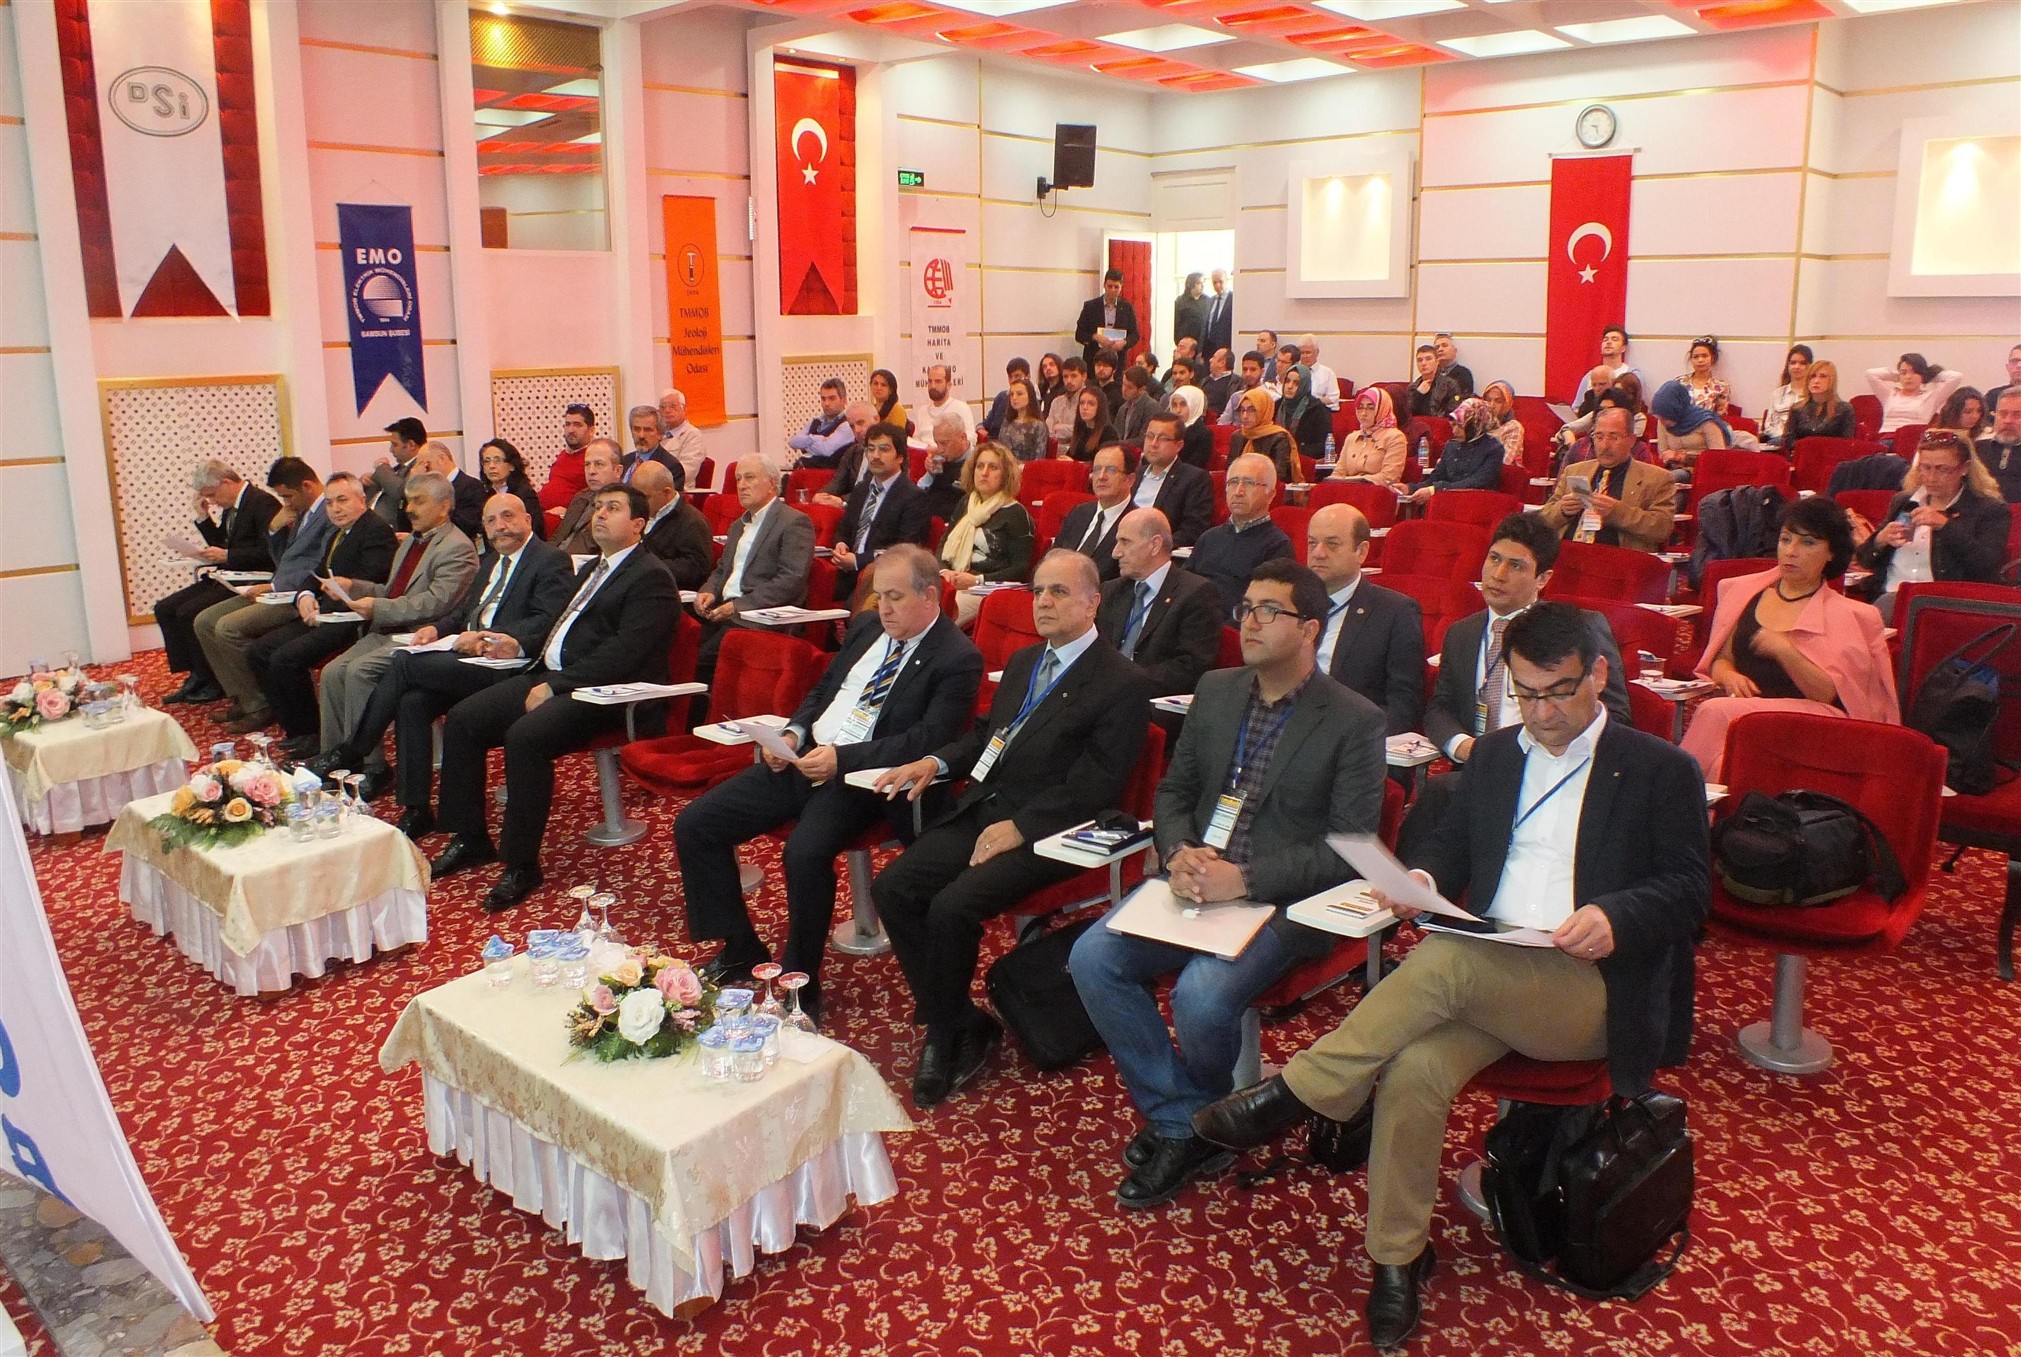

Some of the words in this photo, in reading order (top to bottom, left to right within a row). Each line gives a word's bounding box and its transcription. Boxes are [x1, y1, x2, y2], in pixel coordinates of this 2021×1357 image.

[355, 247, 403, 265] EMO
[679, 307, 710, 318] TMMOB
[684, 327, 708, 338] Jeoloji
[928, 325, 950, 333] TMMOB
[927, 338, 951, 346] HARİTA
[935, 352, 944, 360] VE
